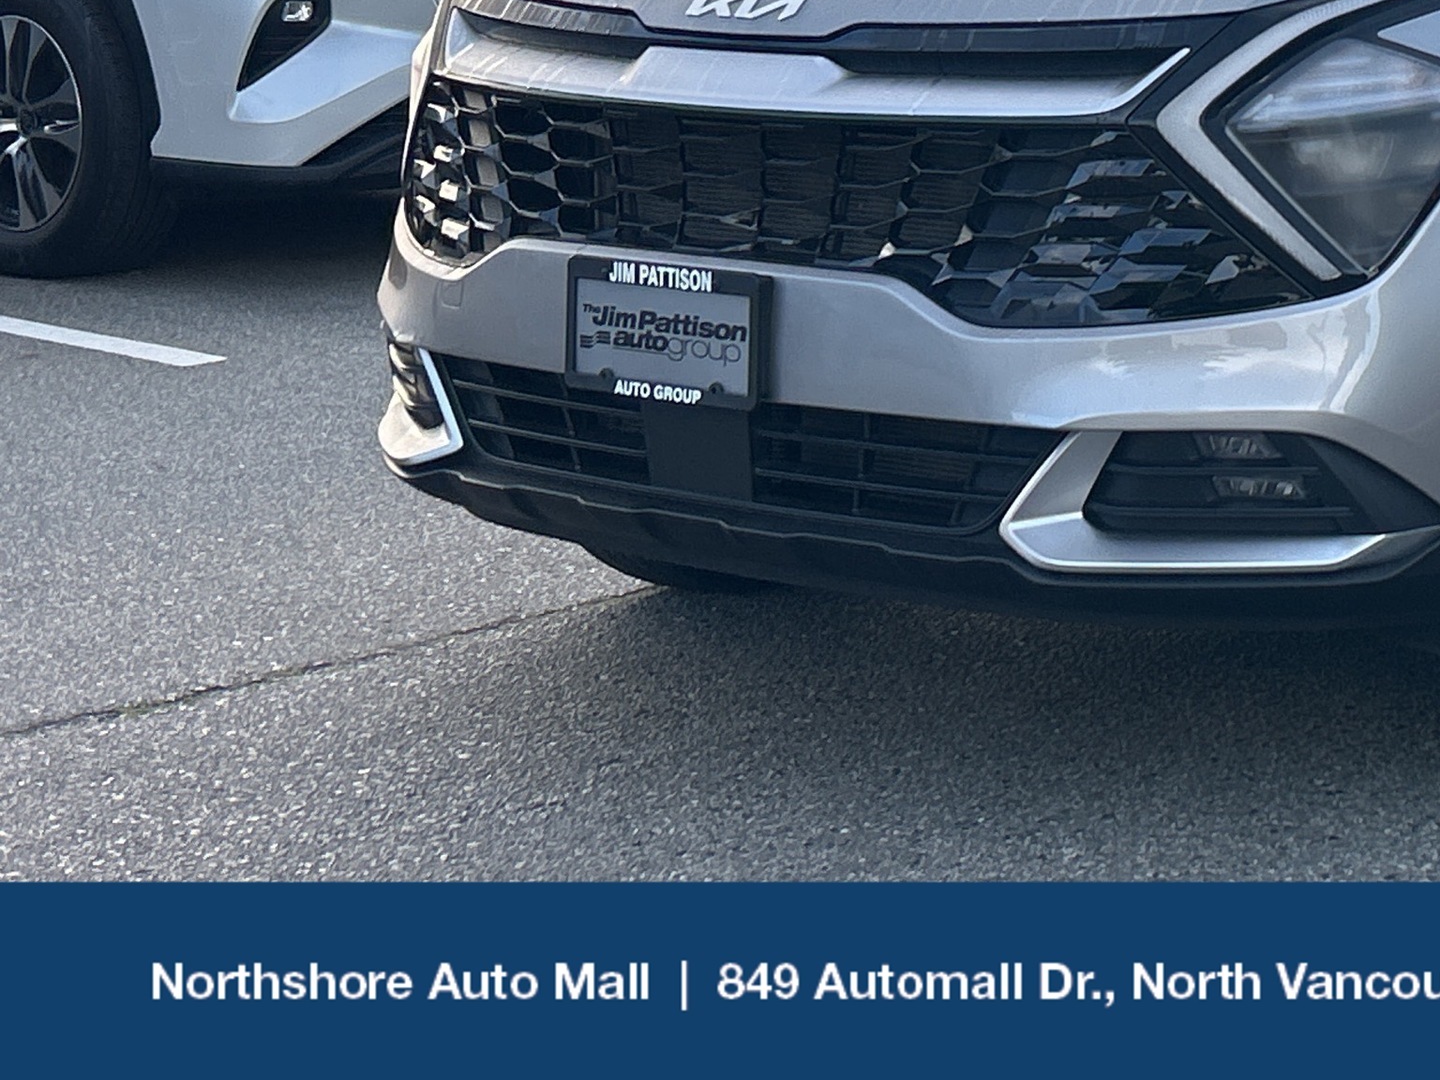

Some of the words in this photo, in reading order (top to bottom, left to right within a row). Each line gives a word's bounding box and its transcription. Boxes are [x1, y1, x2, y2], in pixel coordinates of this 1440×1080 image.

[609, 261, 636, 284] JIM
[638, 263, 713, 293] PATTISON
[582, 303, 601, 315] The
[613, 379, 651, 399] AUTO
[653, 384, 702, 405] GROUP
